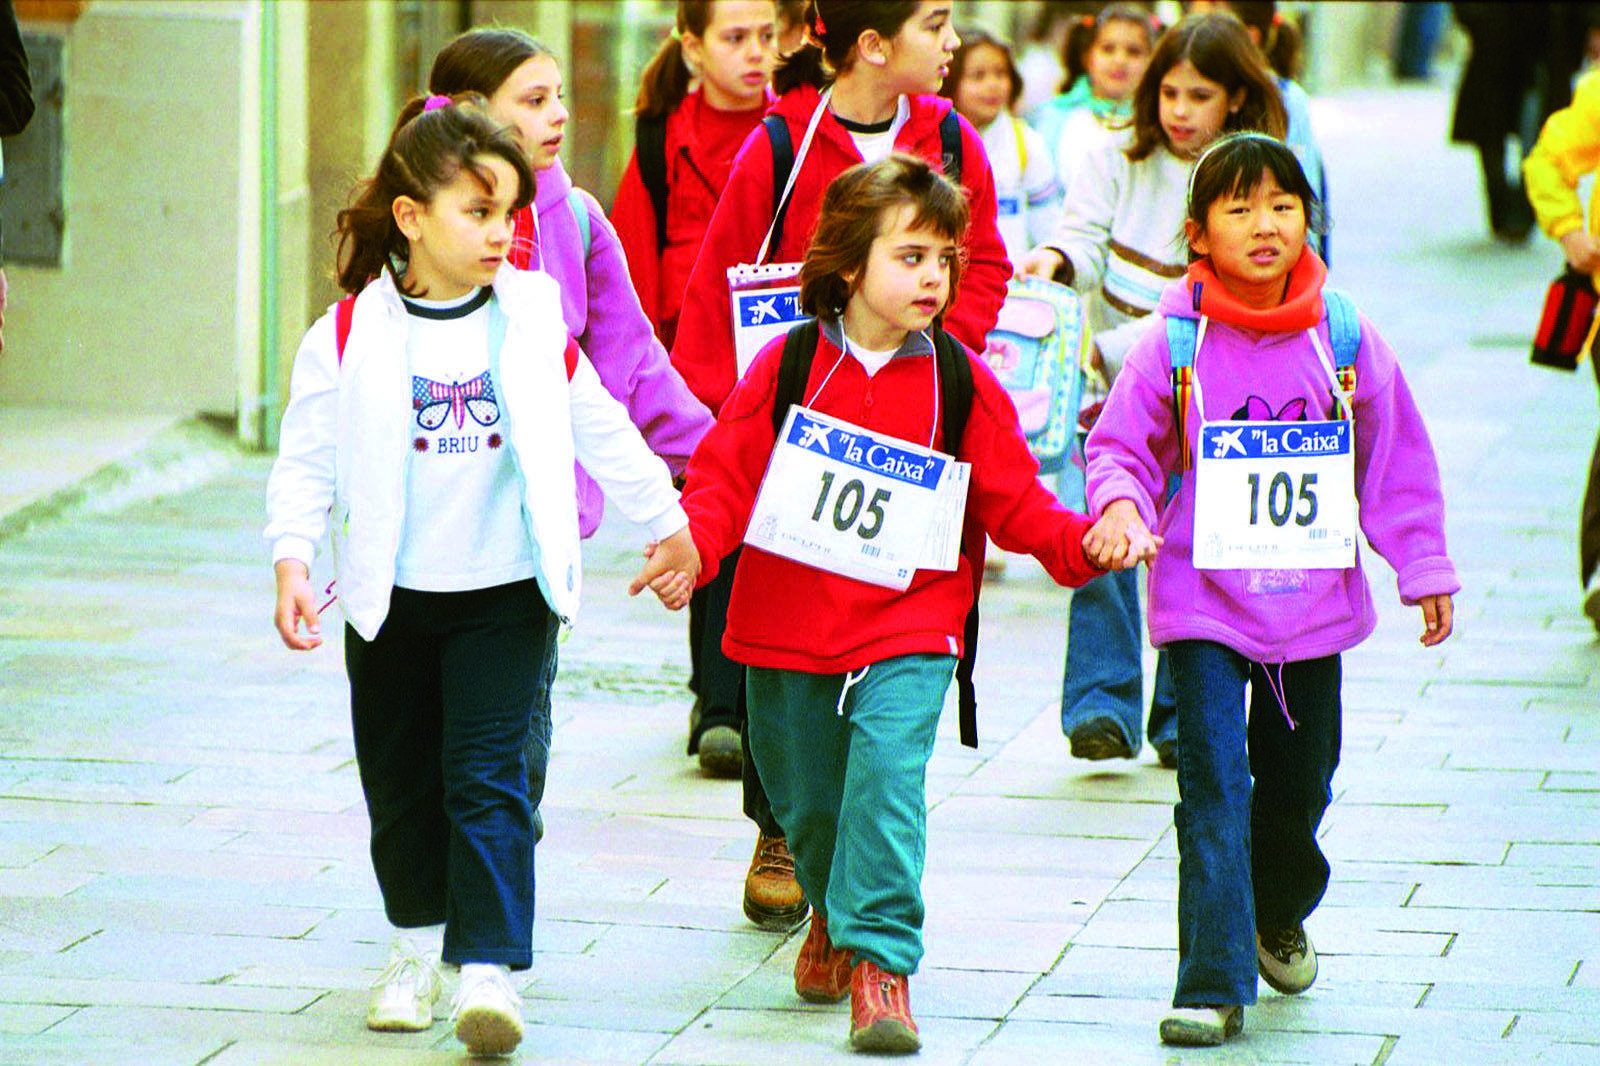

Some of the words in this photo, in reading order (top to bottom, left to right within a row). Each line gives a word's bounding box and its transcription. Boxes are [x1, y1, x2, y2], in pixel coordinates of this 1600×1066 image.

[437, 436, 479, 454] BRIU
[839, 432, 863, 463] "la
[866, 444, 935, 482] Caixa"
[1251, 428, 1279, 453] "la
[1281, 426, 1345, 453] Caixa"
[811, 470, 893, 540] 105
[1247, 471, 1319, 527] 105
